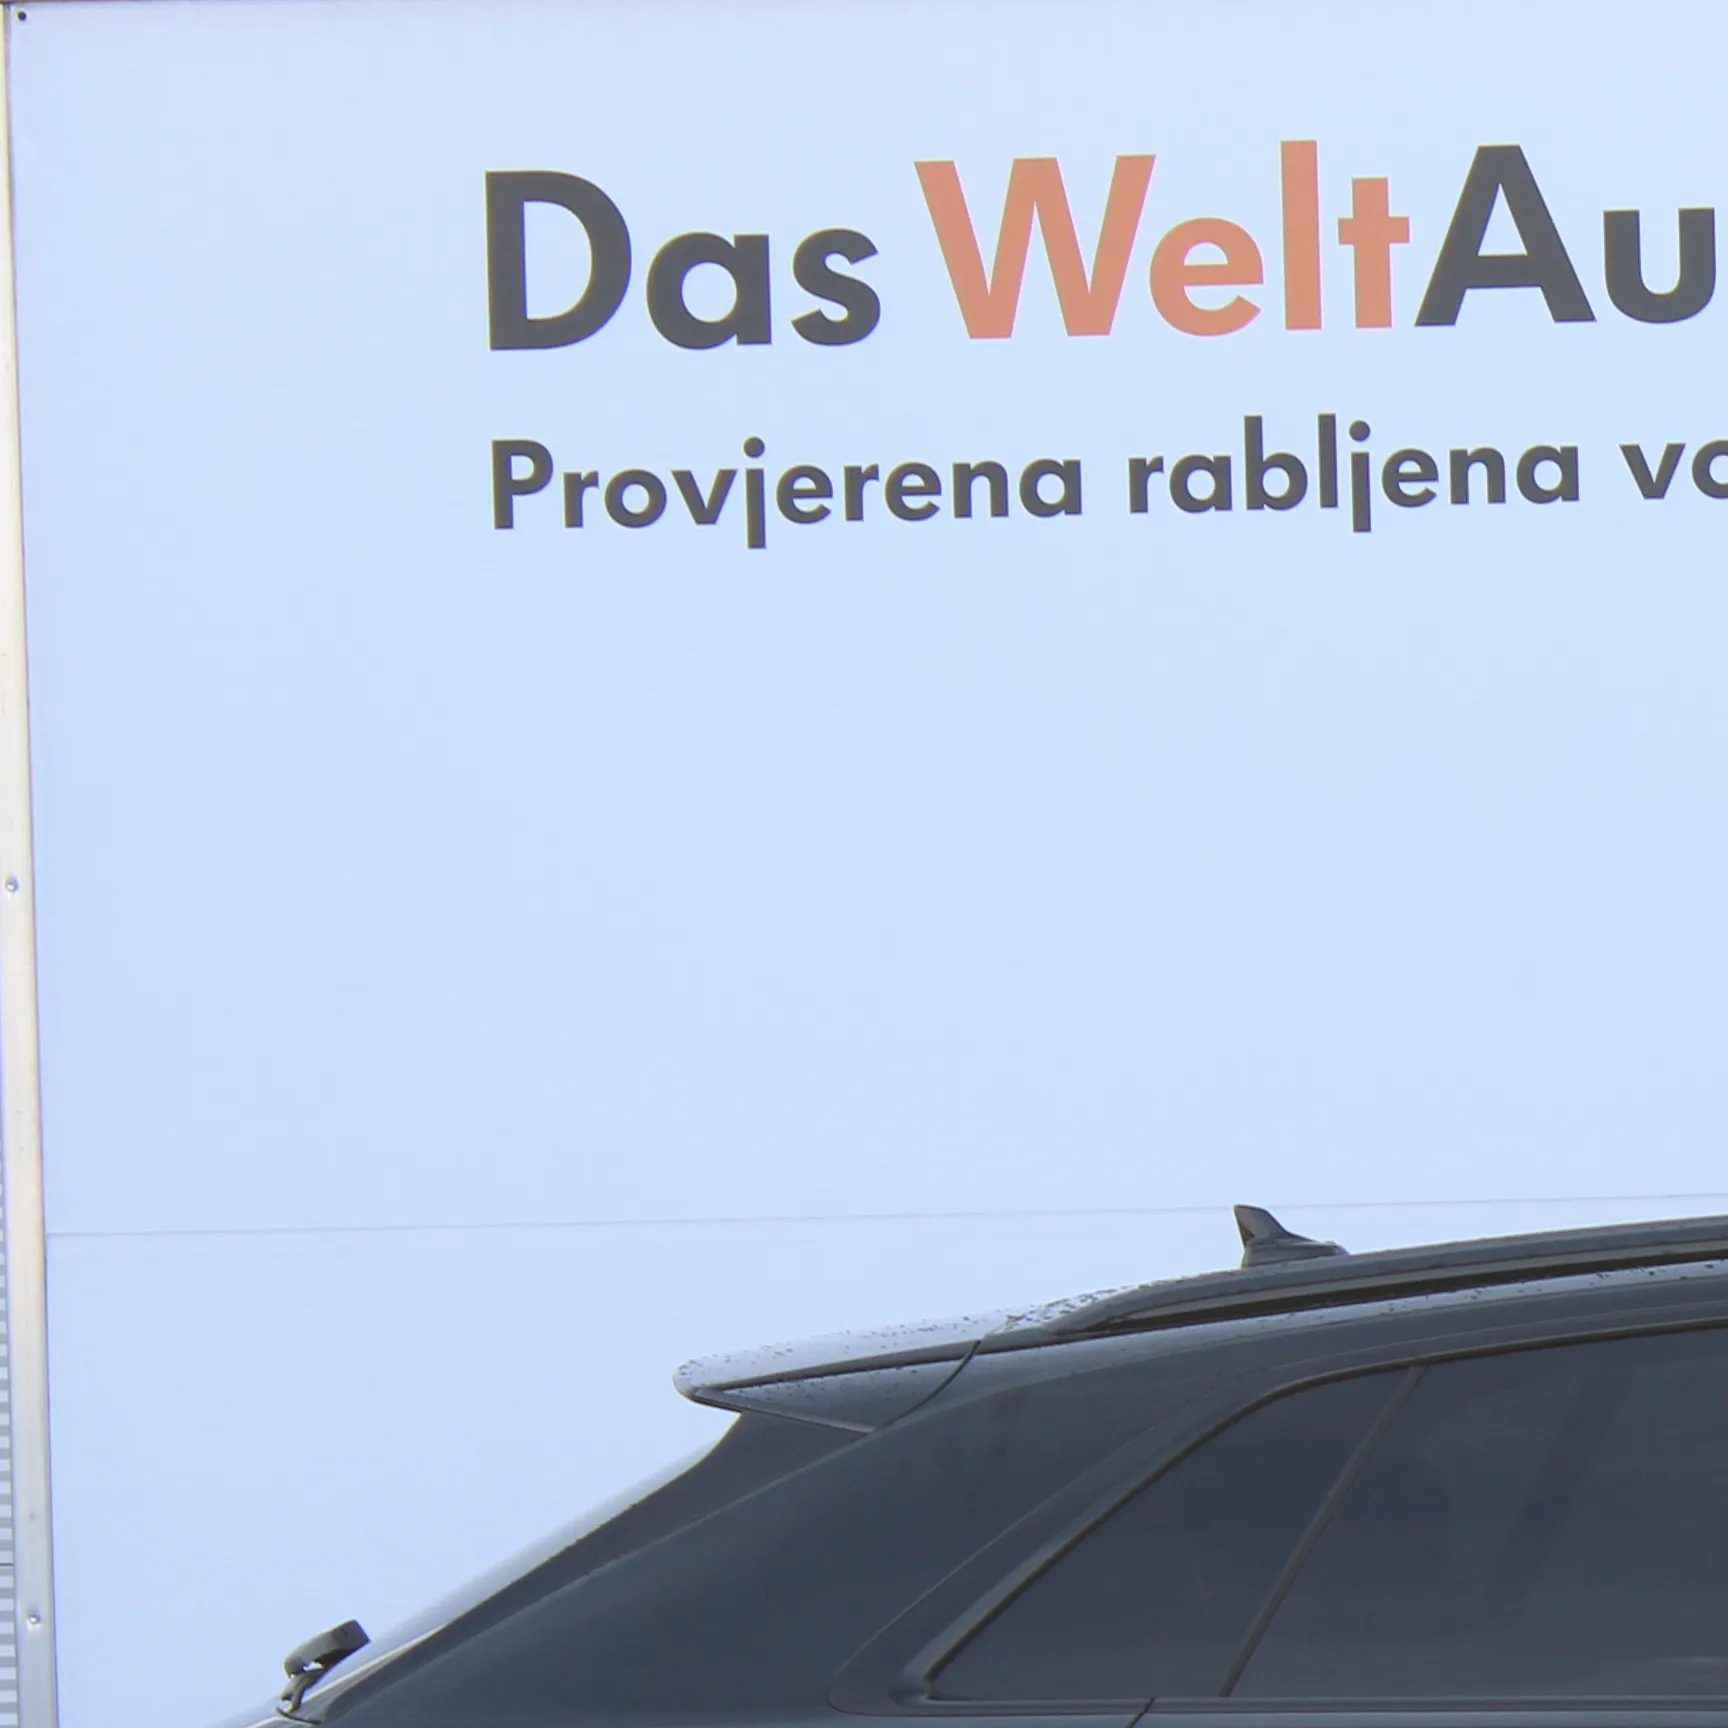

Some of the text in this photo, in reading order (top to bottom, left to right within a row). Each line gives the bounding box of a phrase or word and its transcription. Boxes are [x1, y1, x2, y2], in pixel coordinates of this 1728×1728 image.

[485, 170, 880, 350] Das
[491, 439, 1081, 549] Provjerena
[1128, 413, 1579, 532] rabljena
